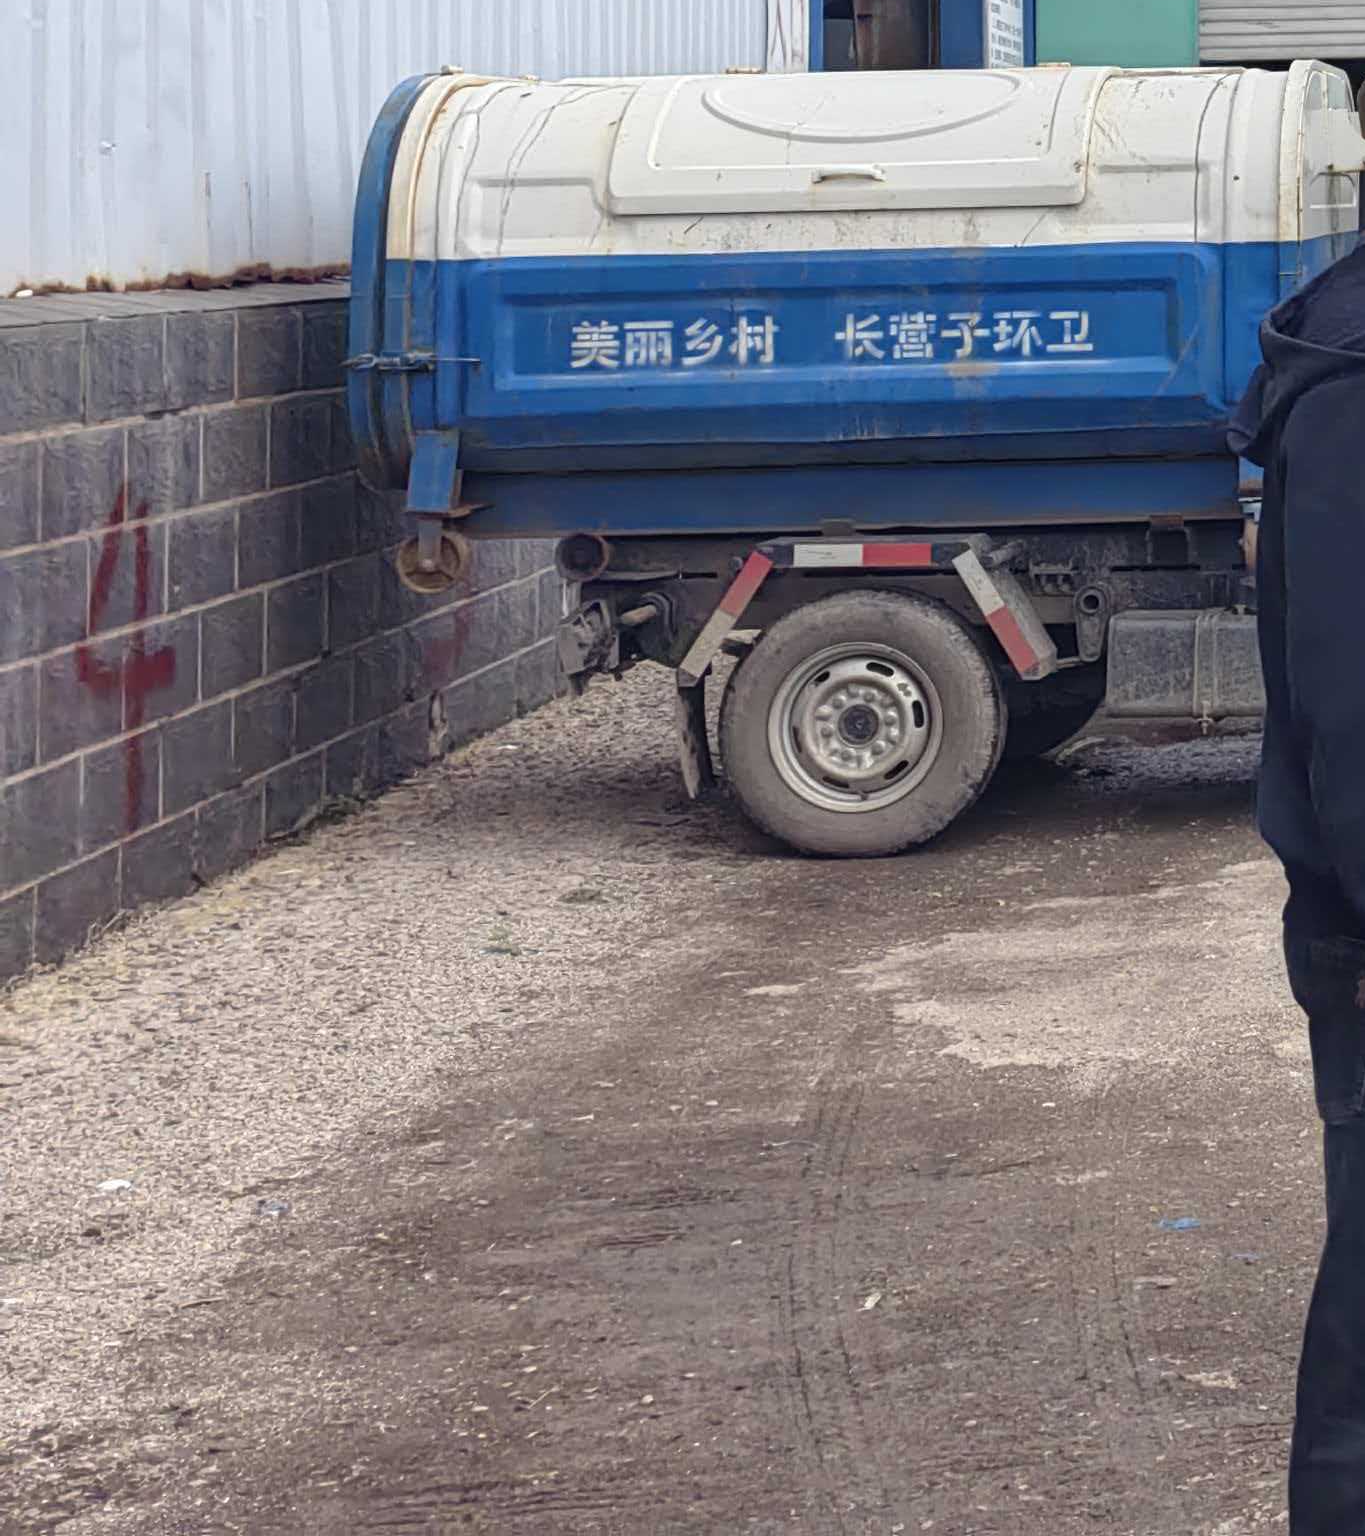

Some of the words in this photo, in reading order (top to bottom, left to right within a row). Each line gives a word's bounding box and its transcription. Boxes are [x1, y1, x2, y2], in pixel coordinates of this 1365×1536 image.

[570, 315, 780, 369] 美丽乡村
[834, 310, 1094, 360] 长营子环卫
